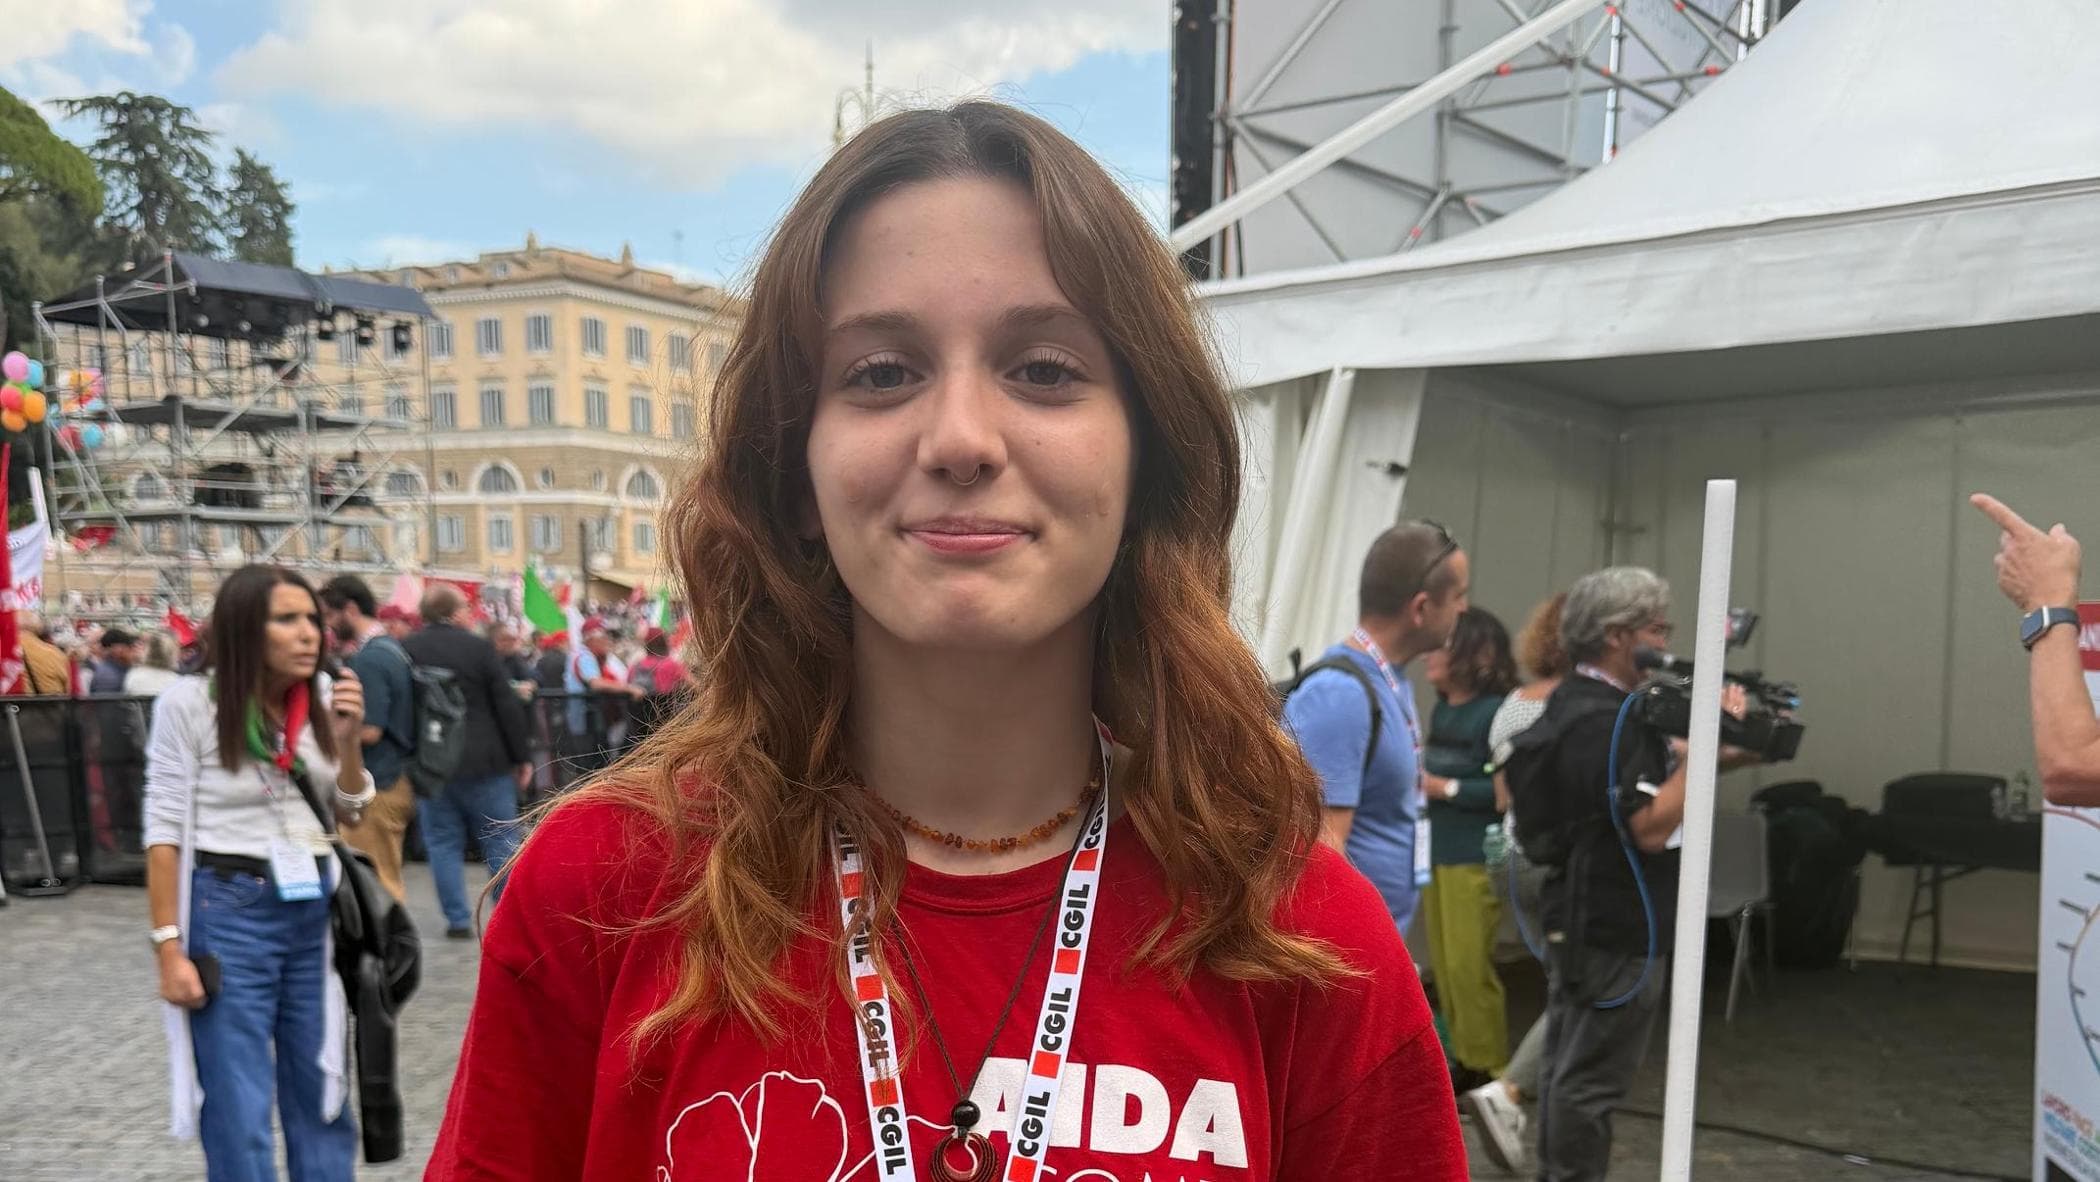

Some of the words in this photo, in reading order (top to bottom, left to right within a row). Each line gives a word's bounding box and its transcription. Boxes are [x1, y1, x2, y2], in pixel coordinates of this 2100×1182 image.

[1061, 883, 1090, 948] CGIL
[863, 1001, 889, 1067] CGIL
[1040, 987, 1072, 1051] CGIL
[877, 1106, 906, 1175] CGIL
[964, 1056, 1249, 1169] AIDA
[1017, 1091, 1050, 1157] CGIL
